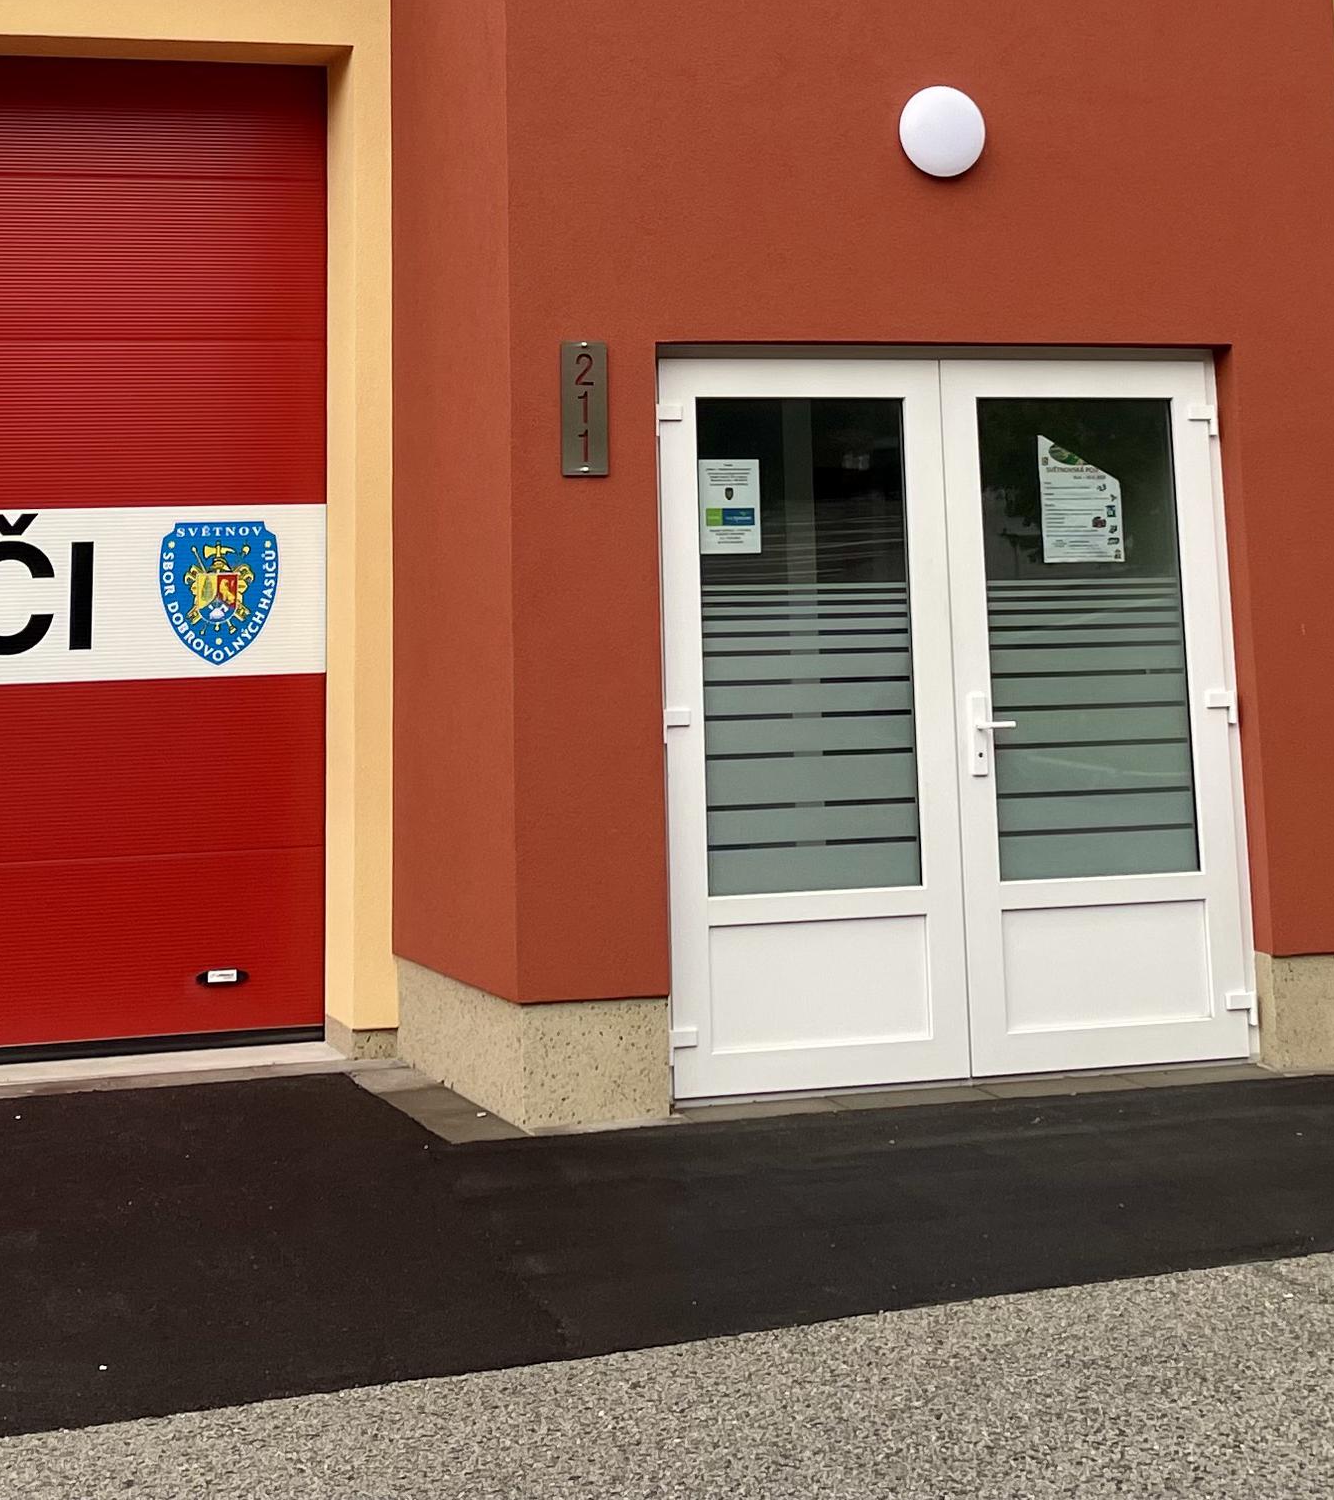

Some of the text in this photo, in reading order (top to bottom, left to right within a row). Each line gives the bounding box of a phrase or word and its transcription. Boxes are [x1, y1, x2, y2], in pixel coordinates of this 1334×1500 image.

[575, 354, 594, 462] 211
[176, 526, 262, 537] SVĚTNOV
[163, 550, 276, 661] SBOR DOBROVOLNÝCH HASIČŮ
